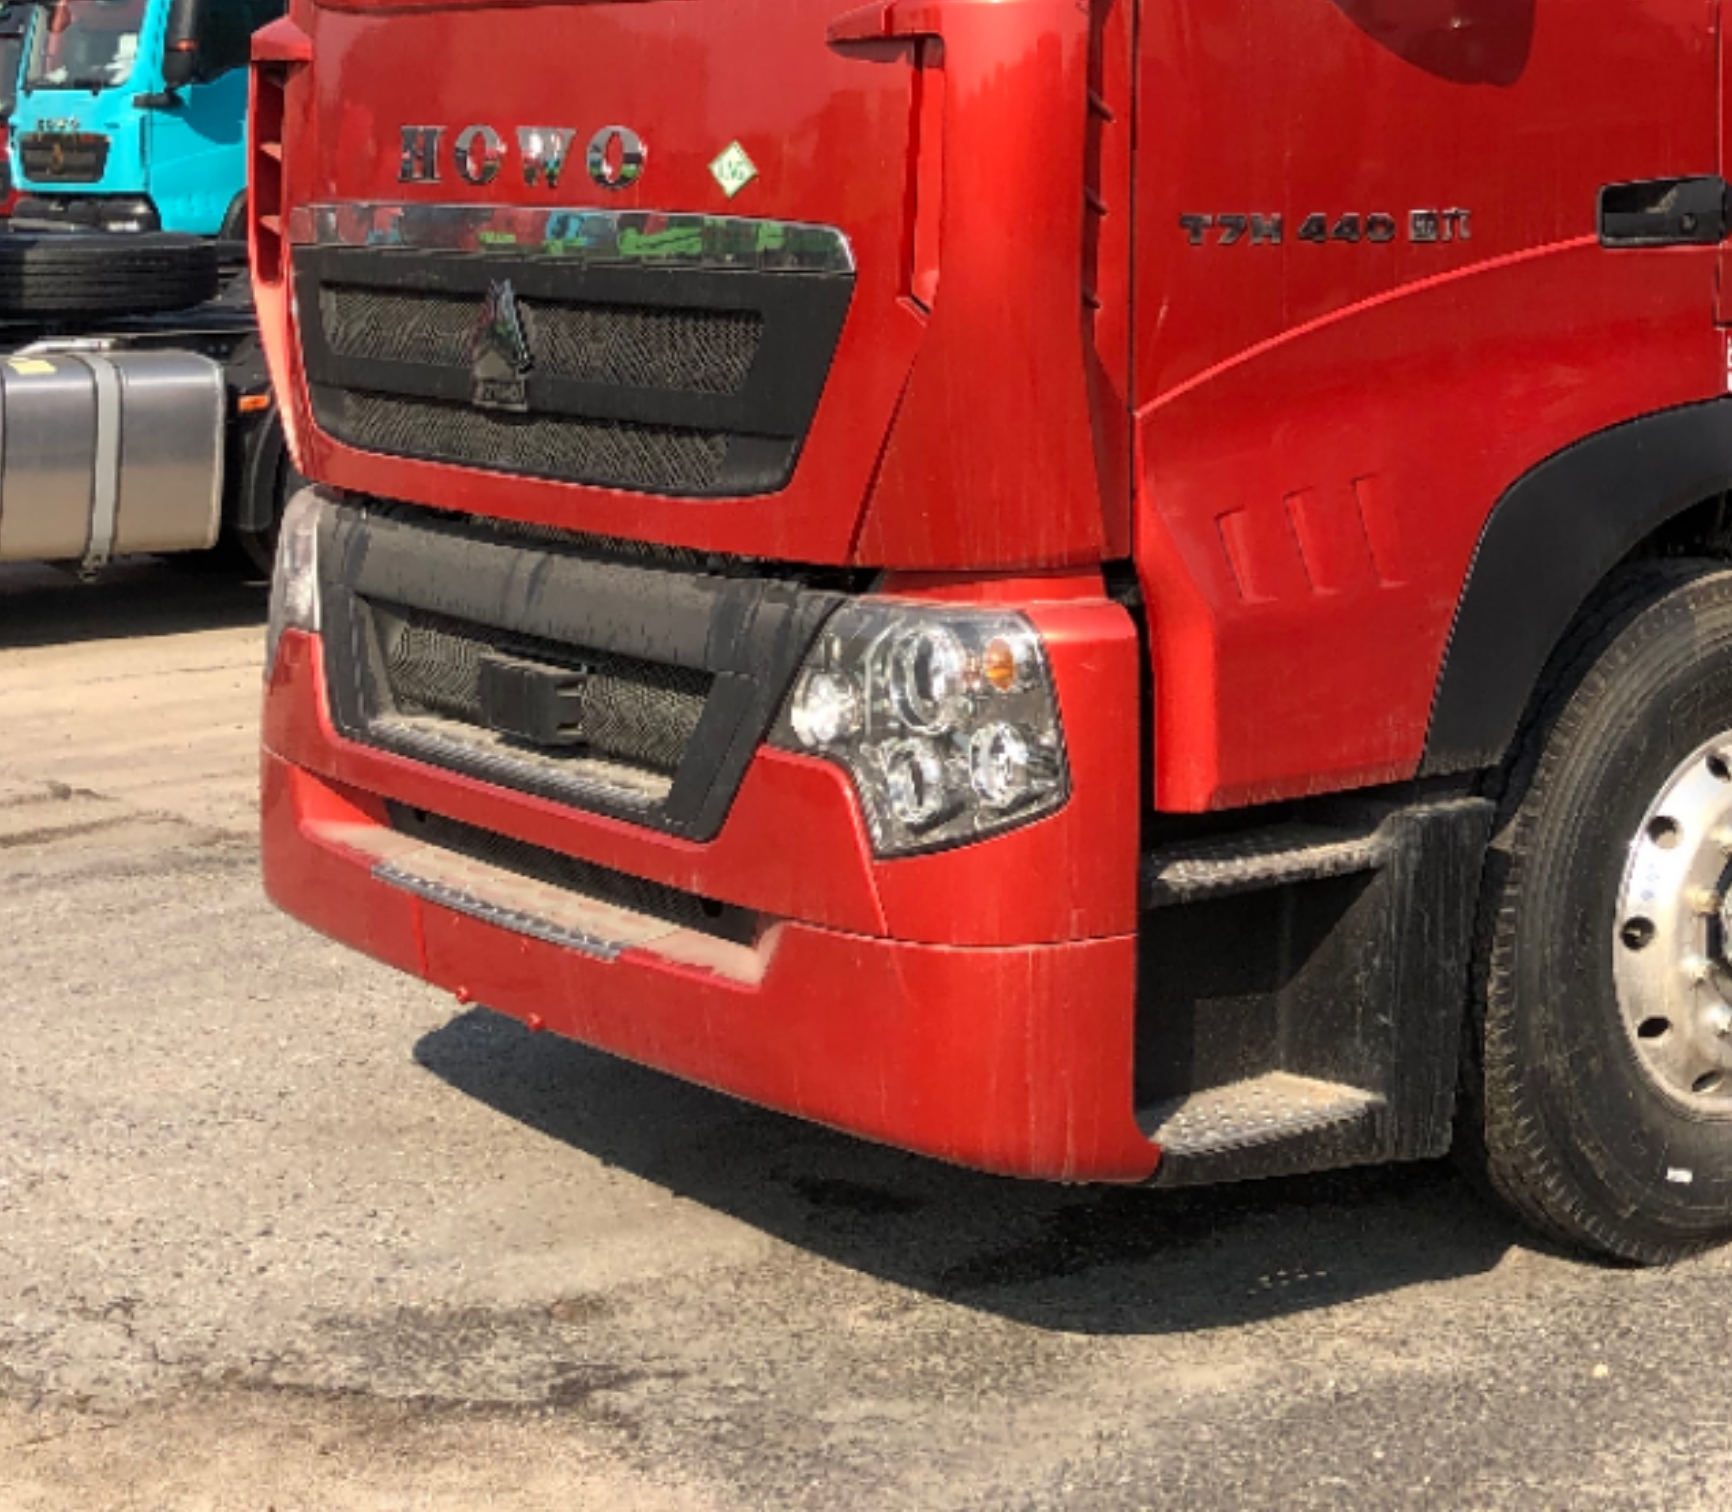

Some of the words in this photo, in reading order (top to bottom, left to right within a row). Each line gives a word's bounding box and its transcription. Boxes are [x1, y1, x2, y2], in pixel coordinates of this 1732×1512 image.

[397, 124, 649, 189] HOWO
[1179, 212, 1284, 246] T7H
[1297, 212, 1396, 244] 440
